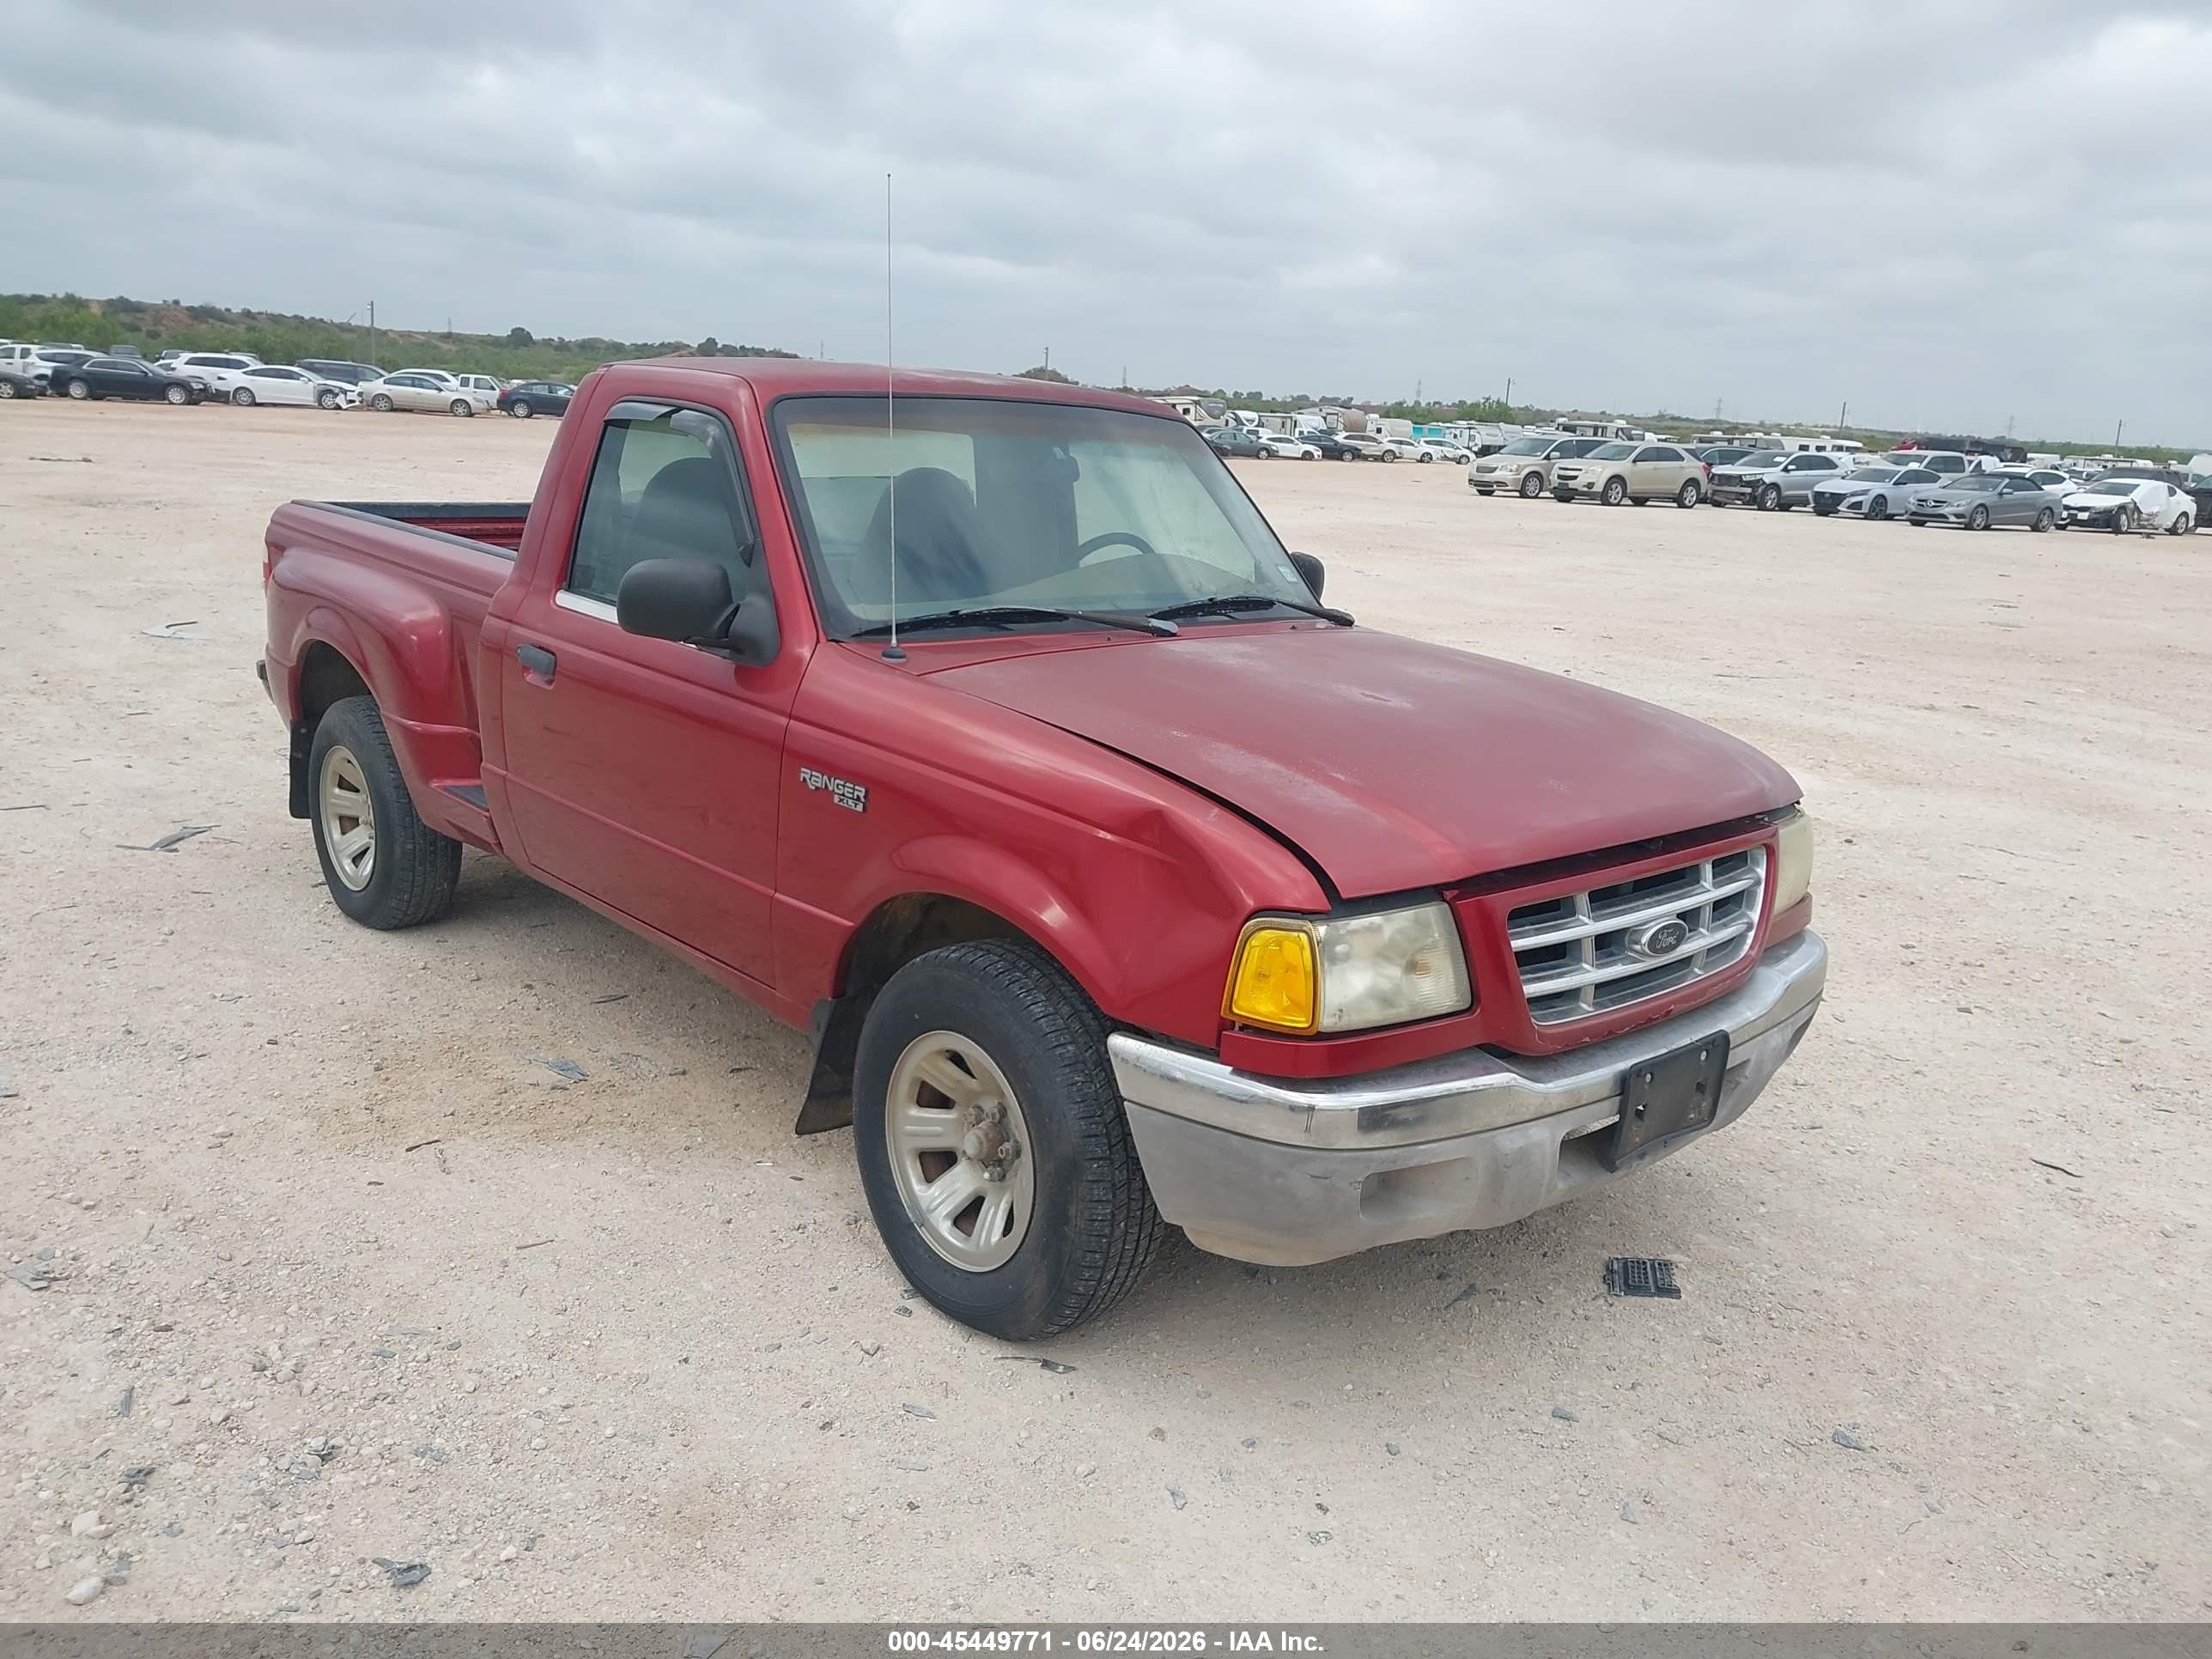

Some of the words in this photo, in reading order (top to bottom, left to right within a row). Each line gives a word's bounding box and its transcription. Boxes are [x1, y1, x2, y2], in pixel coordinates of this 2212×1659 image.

[800, 767, 866, 803] RANGER
[837, 796, 860, 809] XLT
[1656, 927, 1680, 949] Ford
